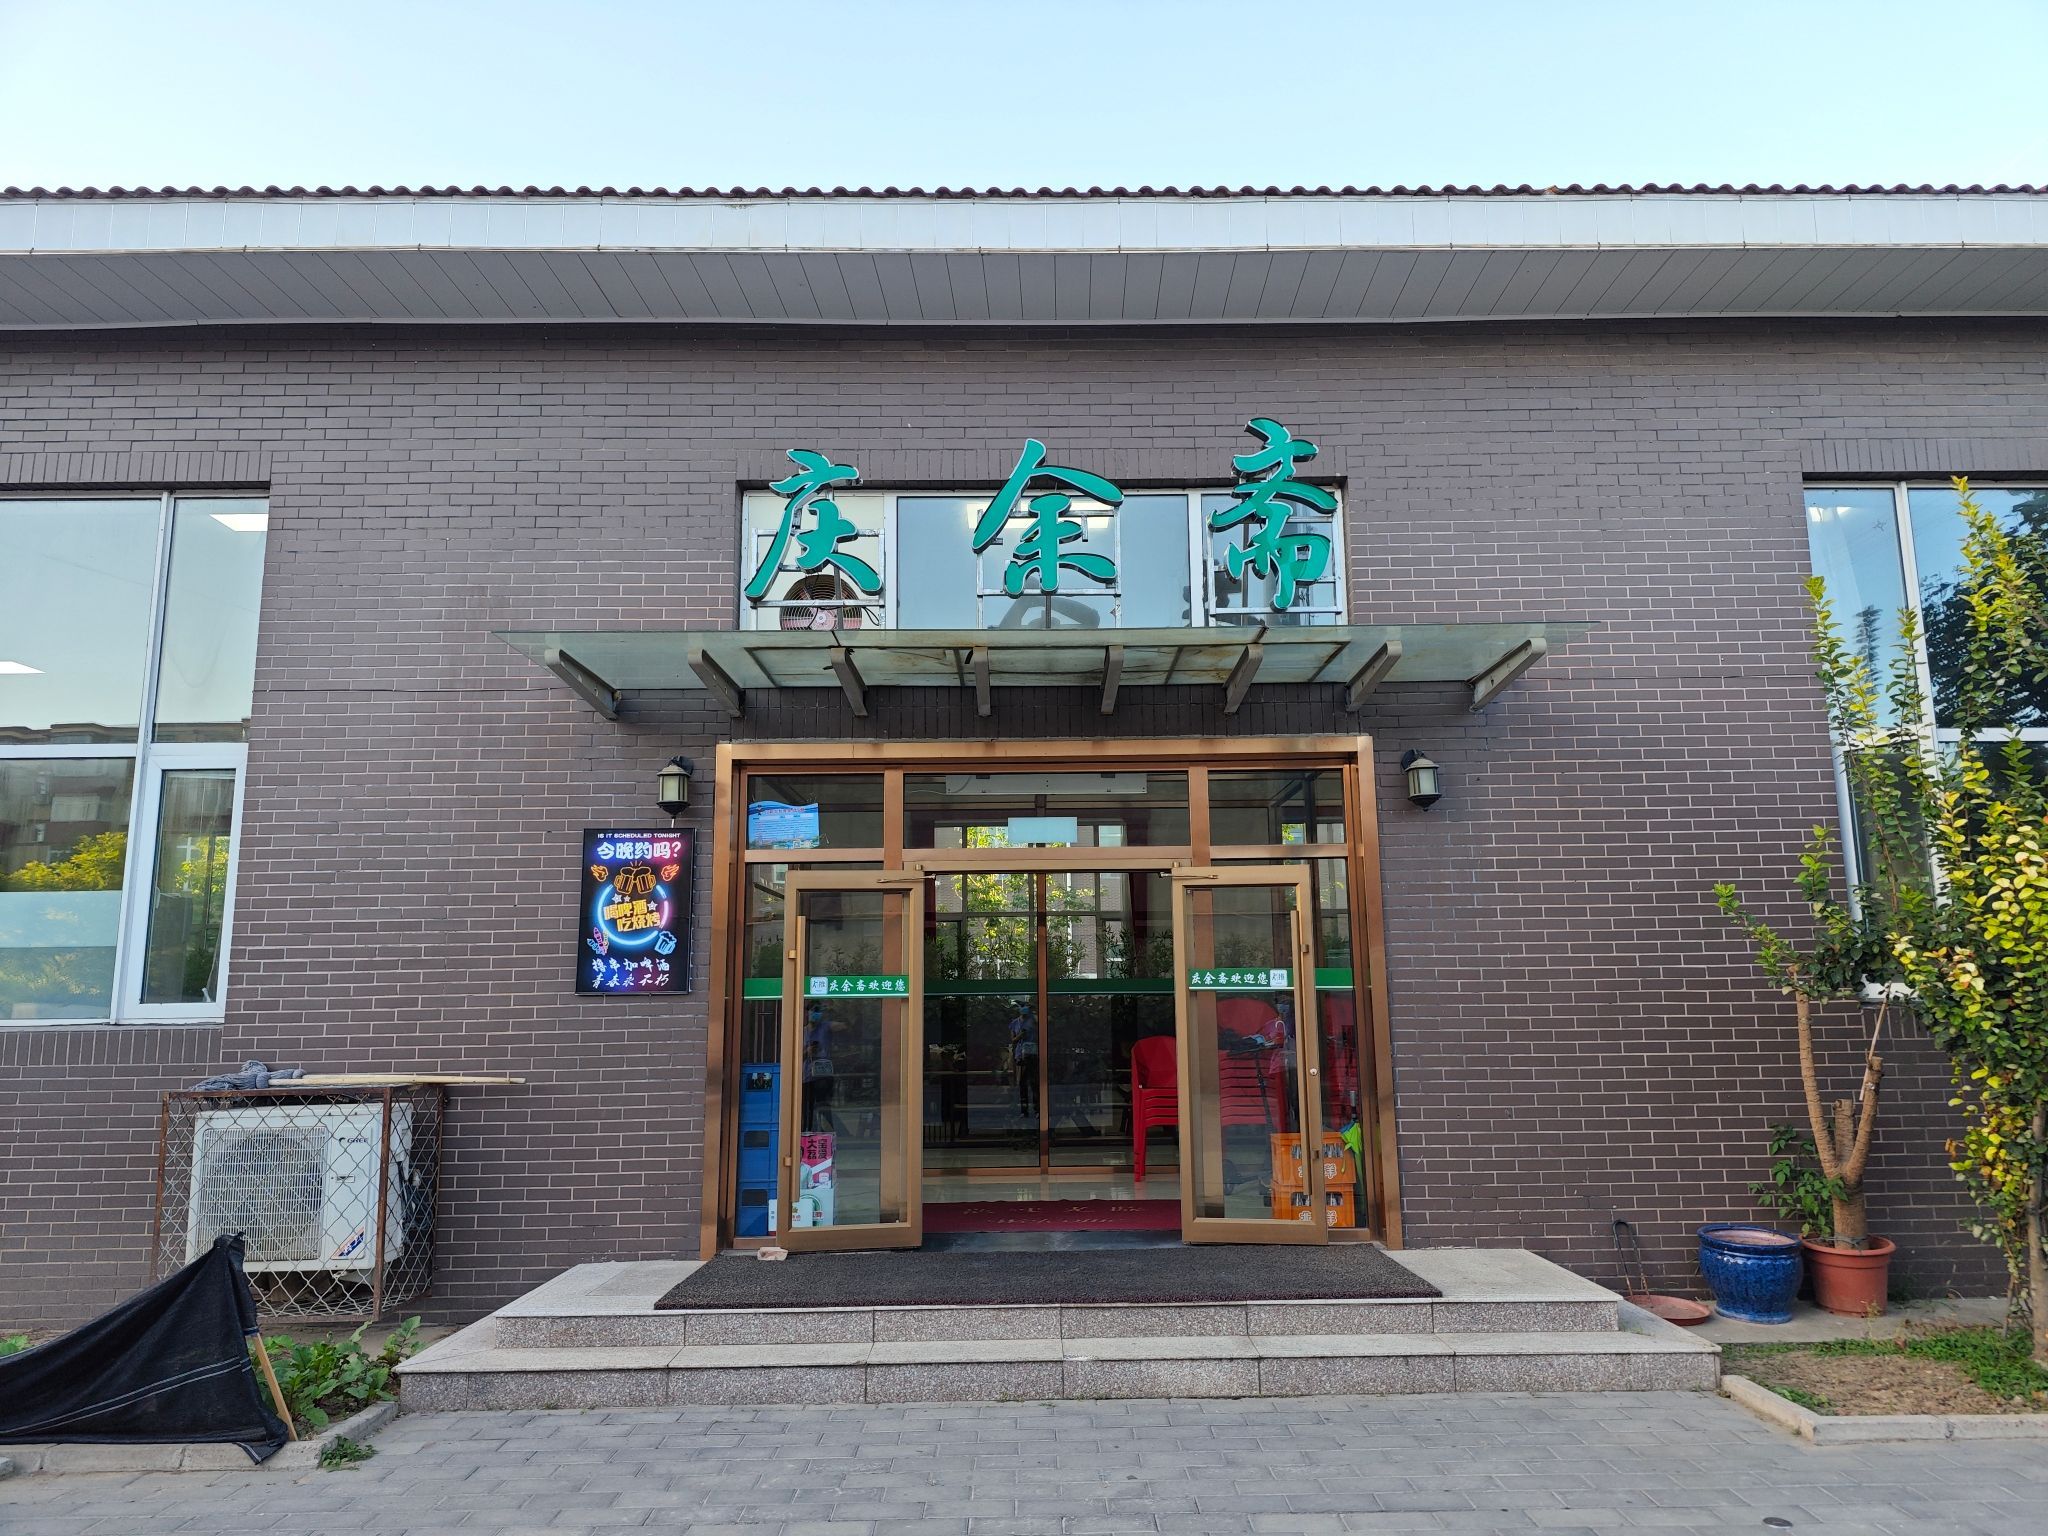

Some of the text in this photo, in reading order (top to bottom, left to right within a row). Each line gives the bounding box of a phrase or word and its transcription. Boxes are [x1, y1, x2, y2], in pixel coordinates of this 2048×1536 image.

[744, 417, 1339, 613] 庆余斋
[603, 899, 648, 921] 喝啤酒
[617, 911, 661, 932] 吃烧烤
[592, 956, 670, 973] 撸串加啤酒
[592, 973, 670, 989] 青春永不朽
[829, 979, 905, 992] 庆余斋欢迎您
[1192, 972, 1268, 985] 庆余斋欢迎您
[1298, 1210, 1338, 1227] 北洋
